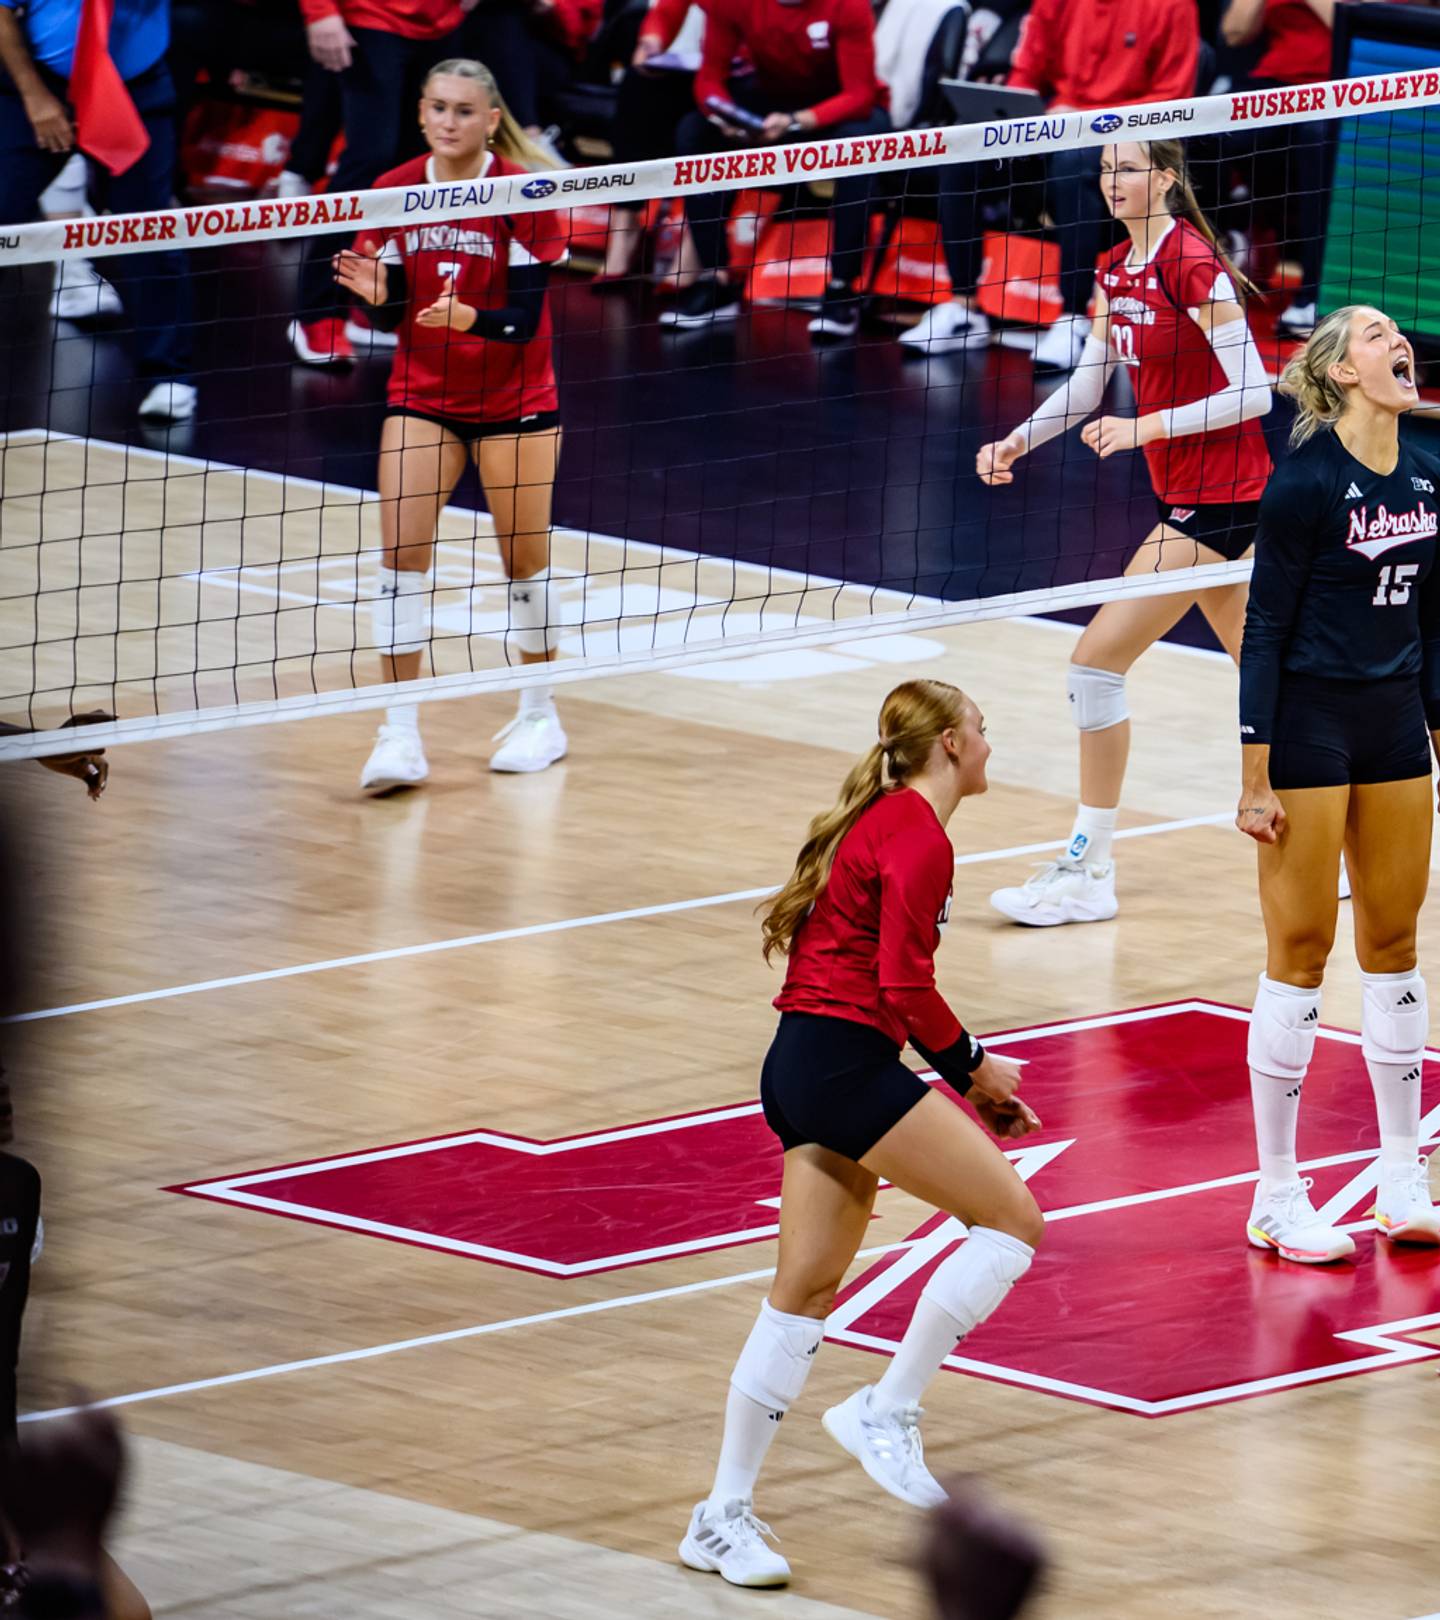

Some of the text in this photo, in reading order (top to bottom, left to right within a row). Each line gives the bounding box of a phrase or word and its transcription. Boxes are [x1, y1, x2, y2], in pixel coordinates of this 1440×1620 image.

[1230, 86, 1326, 121] HUSKER
[984, 108, 1195, 147] DUTEAU SUBARU
[673, 131, 948, 186] HUSKER VOLLEYBALL
[404, 172, 635, 213] DUTEAU SUBARU
[63, 196, 365, 249] HUSKER VOLLEYBALL
[1346, 501, 1438, 545] Nebraska
[1372, 564, 1419, 606] 15
